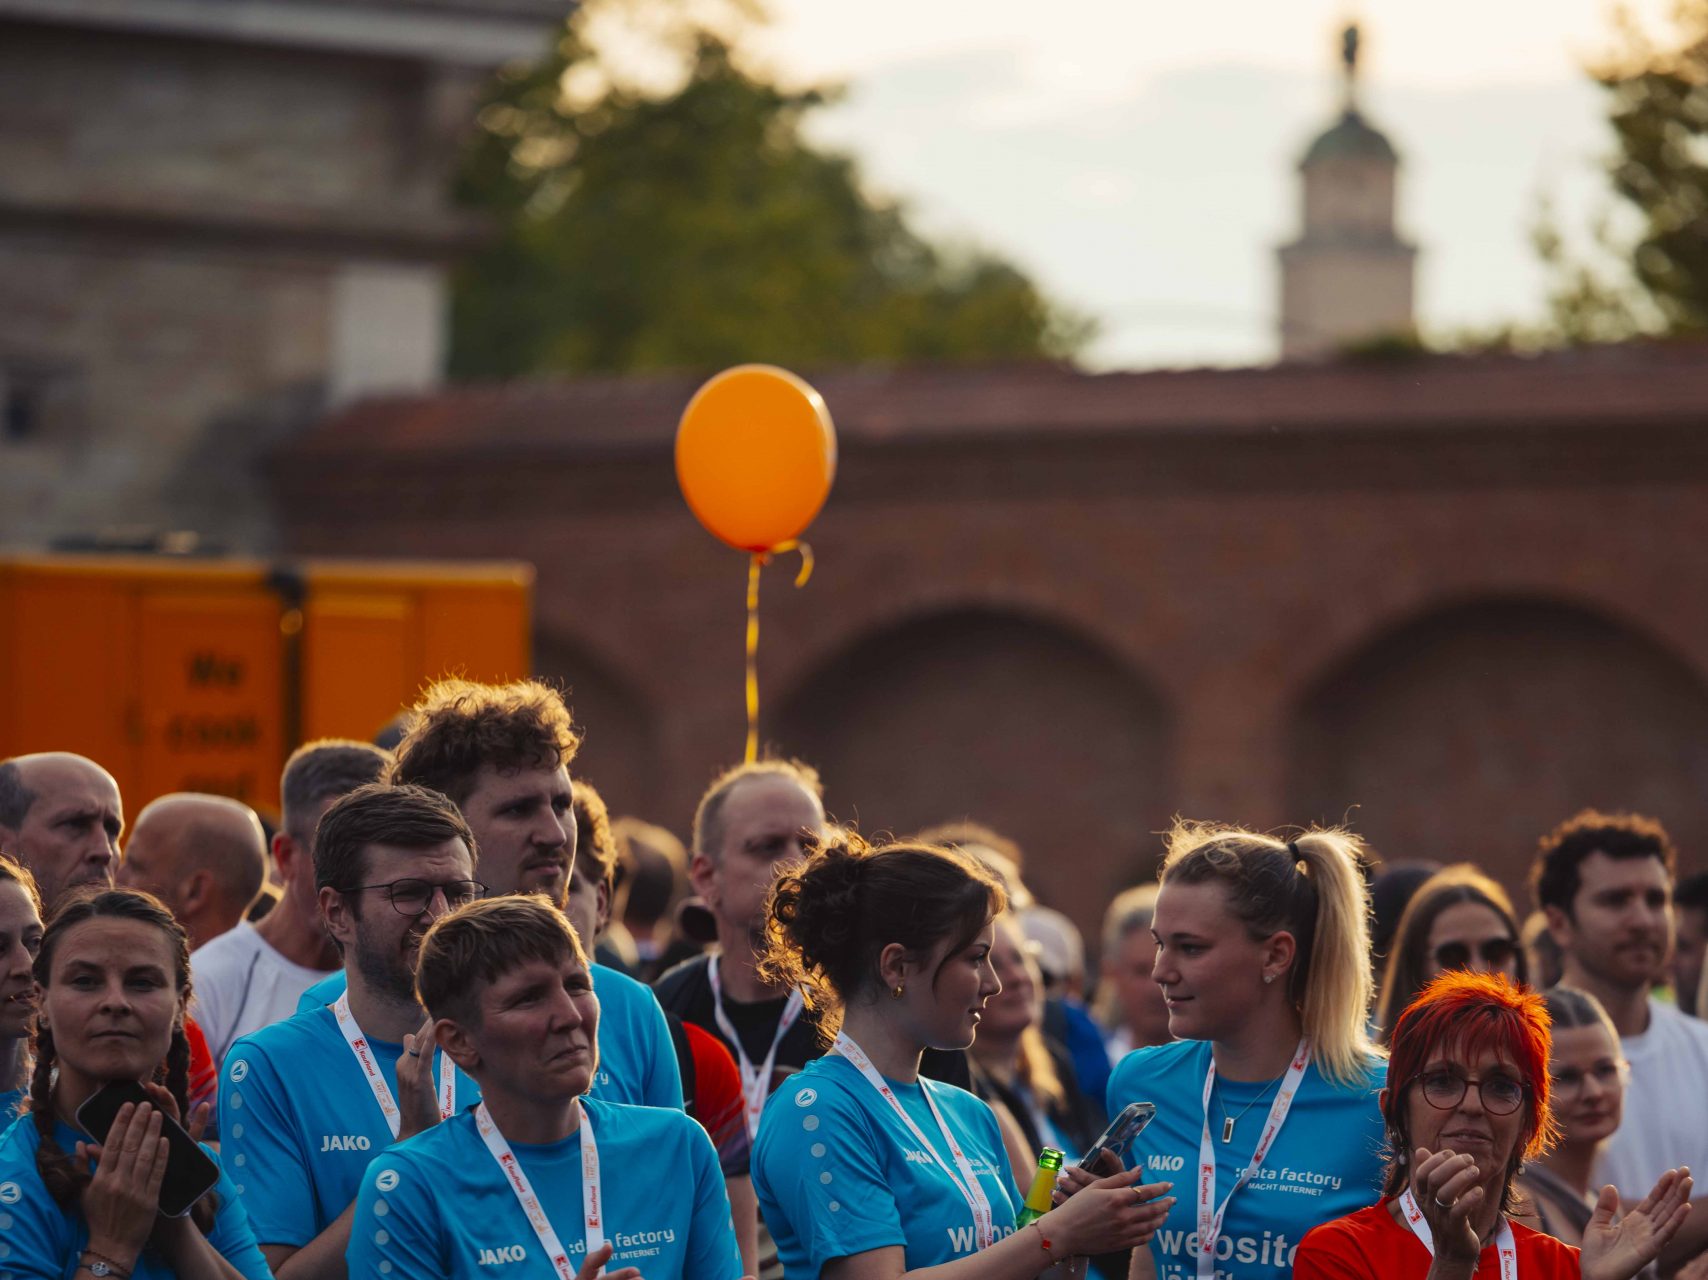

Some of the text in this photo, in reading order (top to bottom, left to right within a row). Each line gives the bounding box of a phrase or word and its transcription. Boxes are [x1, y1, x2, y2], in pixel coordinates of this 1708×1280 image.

[359, 1050, 375, 1077] Kaufland
[320, 1135, 371, 1153] JAKO
[507, 1165, 525, 1193] Kaufland
[1280, 1167, 1342, 1190] factory
[1247, 1182, 1324, 1196] MACHT INTERNET
[615, 1229, 675, 1248] factory
[478, 1244, 527, 1266] JAKO
[620, 1248, 661, 1260] INTERNET
